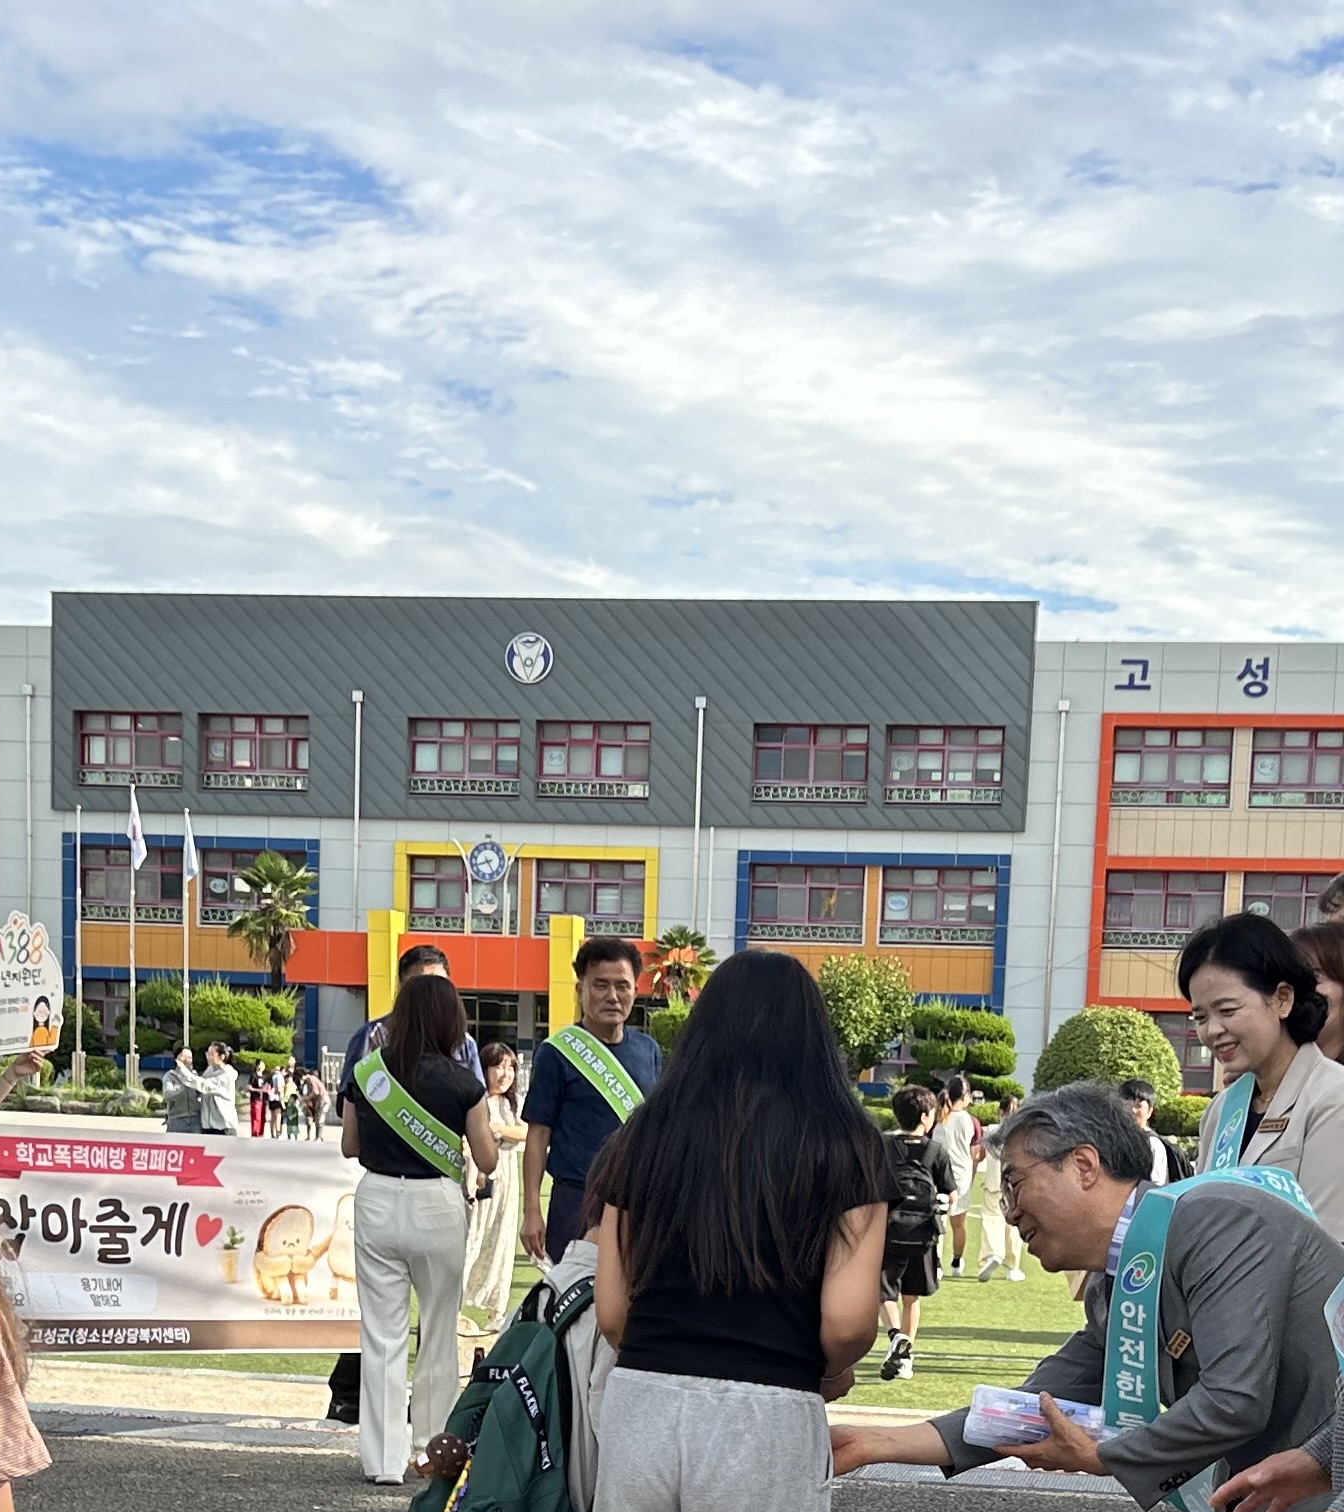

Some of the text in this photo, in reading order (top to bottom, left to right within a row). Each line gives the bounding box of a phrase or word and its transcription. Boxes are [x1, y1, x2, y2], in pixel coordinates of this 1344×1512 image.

[15, 1142, 184, 1172] 학교폭력예방 캠페인
[1116, 1300, 1146, 1404] 안전한
